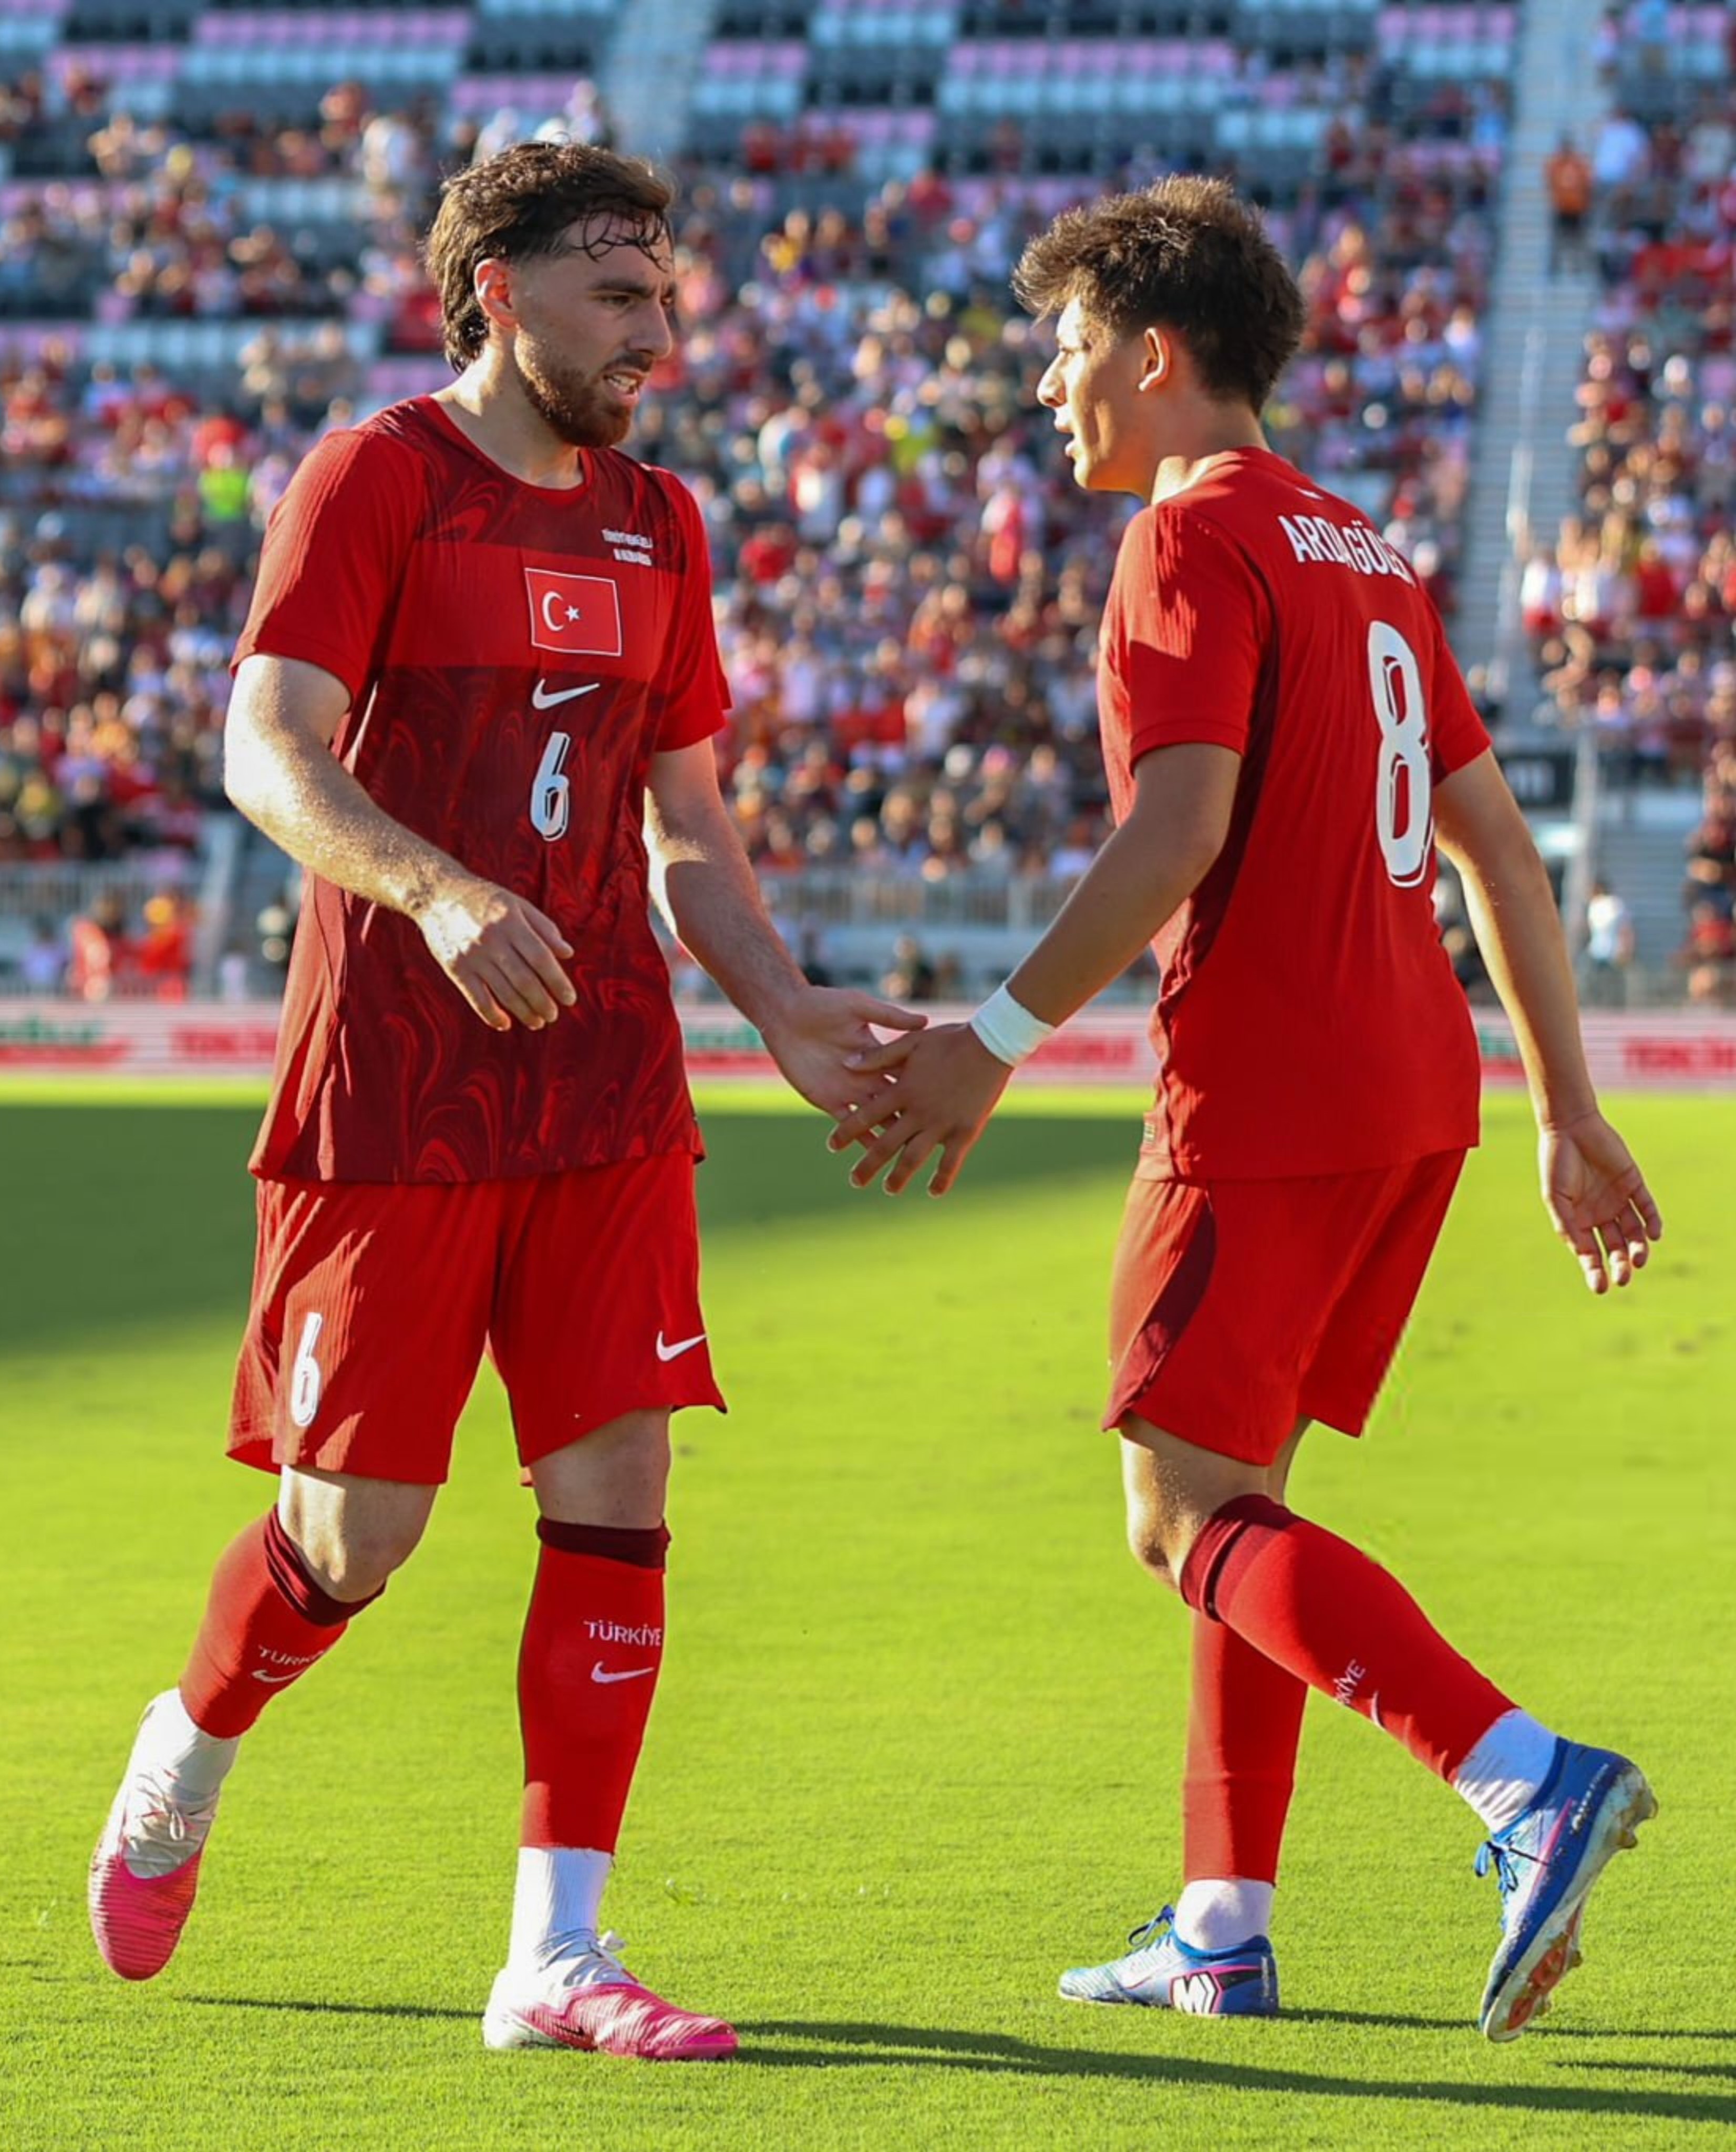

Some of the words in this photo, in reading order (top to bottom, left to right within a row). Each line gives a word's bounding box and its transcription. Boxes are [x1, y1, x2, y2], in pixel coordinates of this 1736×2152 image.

[530, 731, 571, 842] 6
[1368, 620, 1434, 887] 8
[291, 1312, 323, 1427] 6
[583, 1619, 662, 1647] TÜRKİYE
